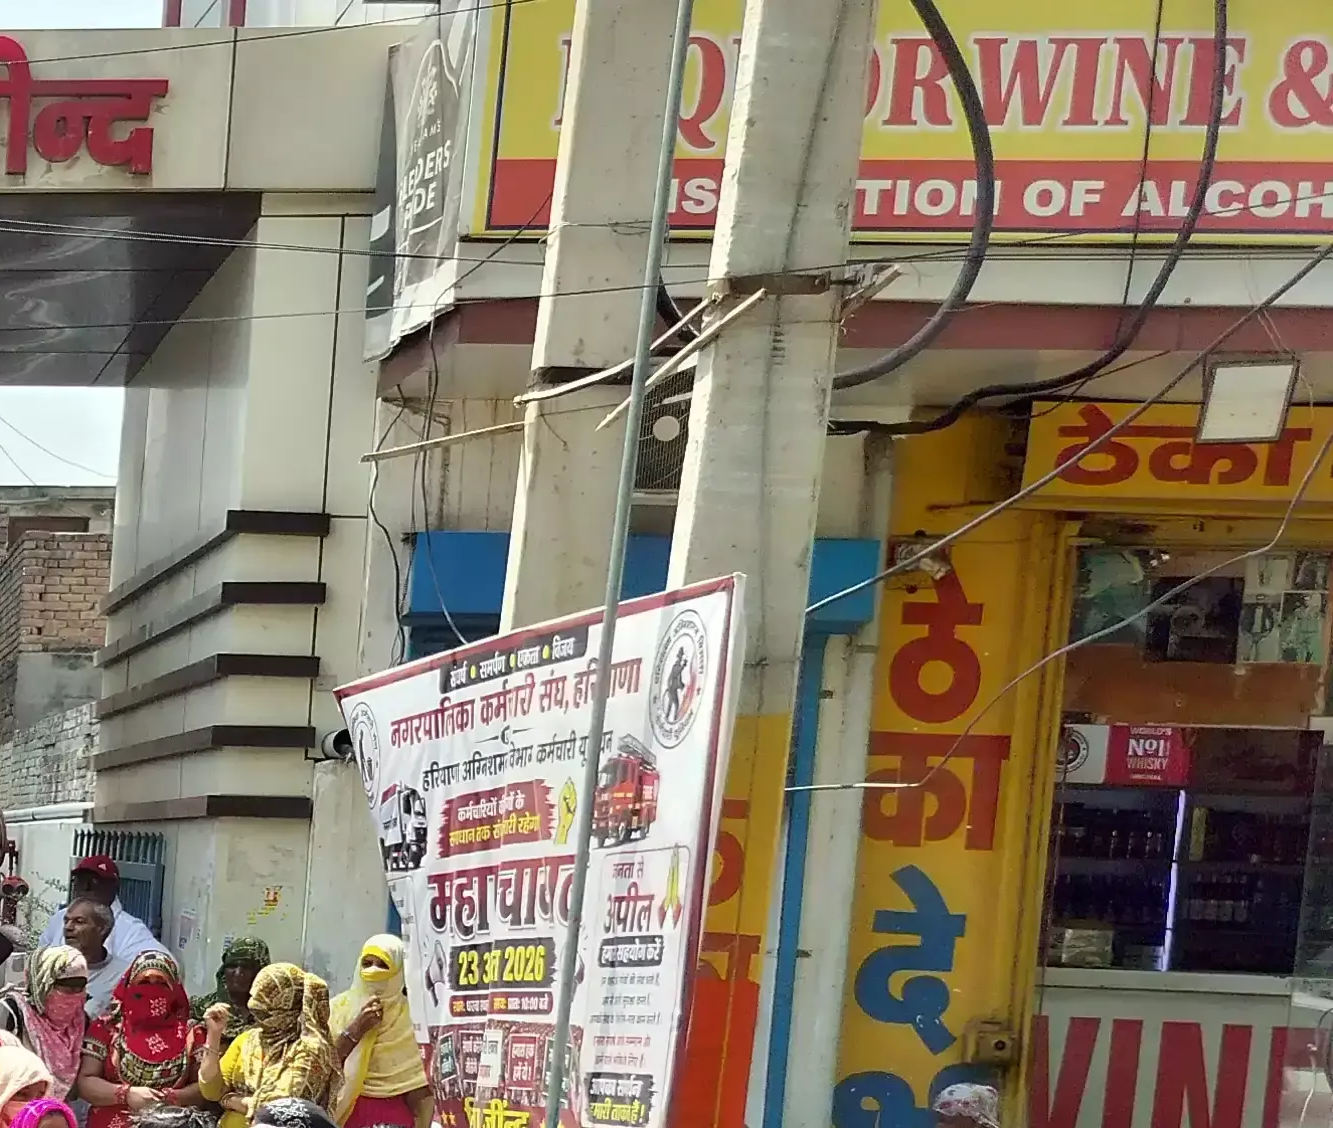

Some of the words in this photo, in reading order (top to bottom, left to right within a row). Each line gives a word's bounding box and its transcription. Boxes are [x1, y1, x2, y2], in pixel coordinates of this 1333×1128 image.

[973, 37, 1246, 127] WINE
[1267, 39, 1333, 129] &
[1023, 180, 1105, 216] OF
[1054, 403, 1313, 487] ठेका
[1126, 757, 1170, 771] WHISKY
[603, 881, 655, 934] अपील
[457, 950, 480, 986] 23
[502, 944, 546, 983] 2026
